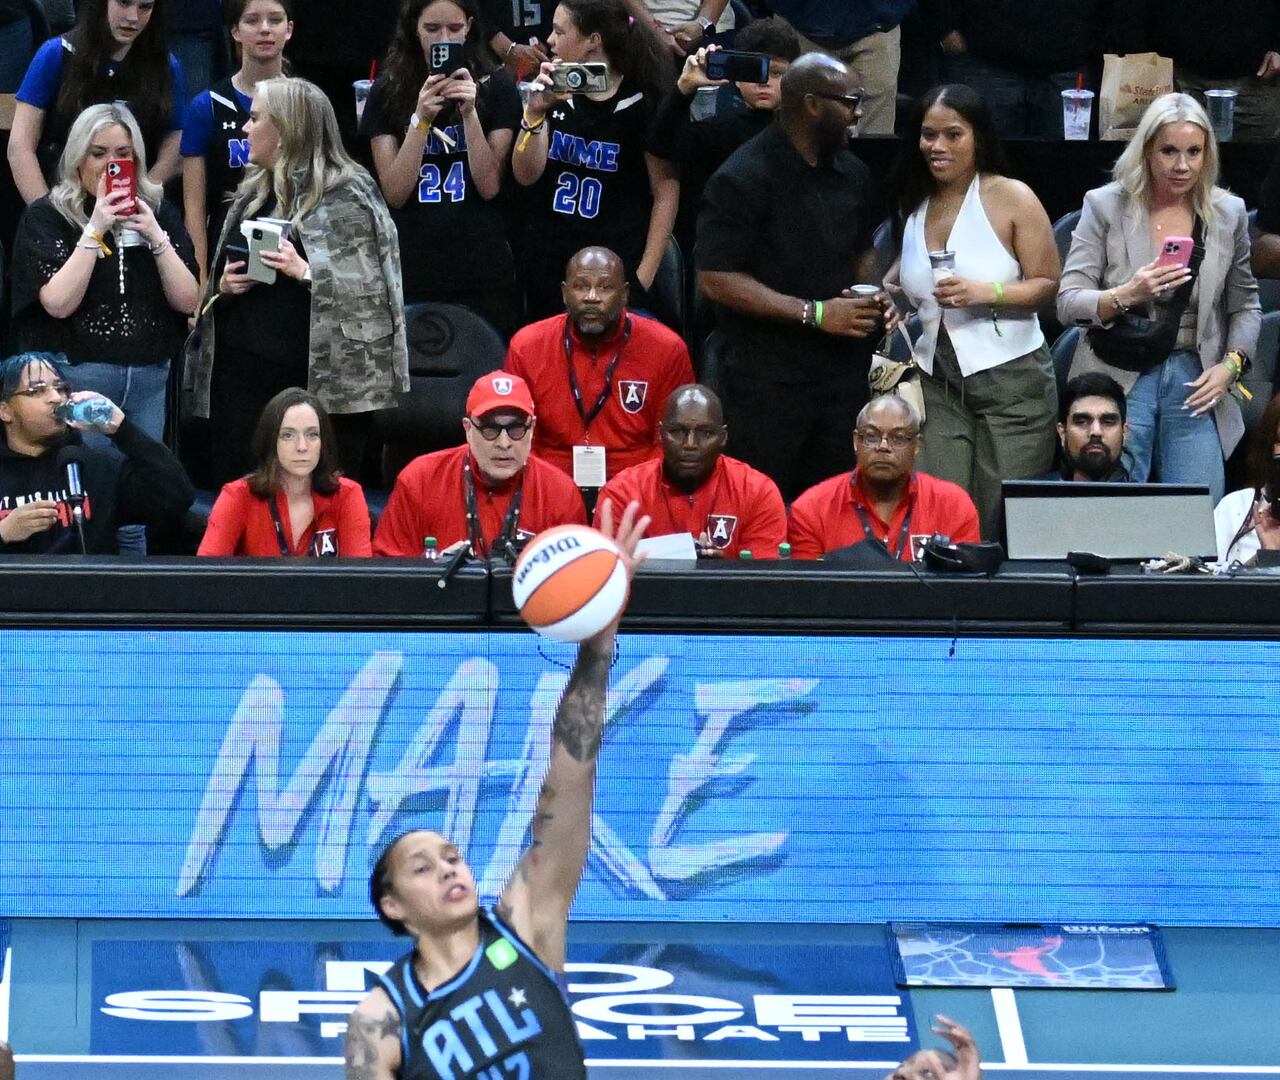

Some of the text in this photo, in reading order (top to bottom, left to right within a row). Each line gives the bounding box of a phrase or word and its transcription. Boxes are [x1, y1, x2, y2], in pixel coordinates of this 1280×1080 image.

[512, 0, 541, 27] 15
[548, 130, 620, 172] NME
[419, 162, 465, 203] 24
[553, 171, 602, 218] 20
[517, 536, 582, 584] Wilson
[177, 650, 820, 902] MAKE
[1063, 925, 1151, 934] Wilson
[627, 1025, 911, 1042] HATE
